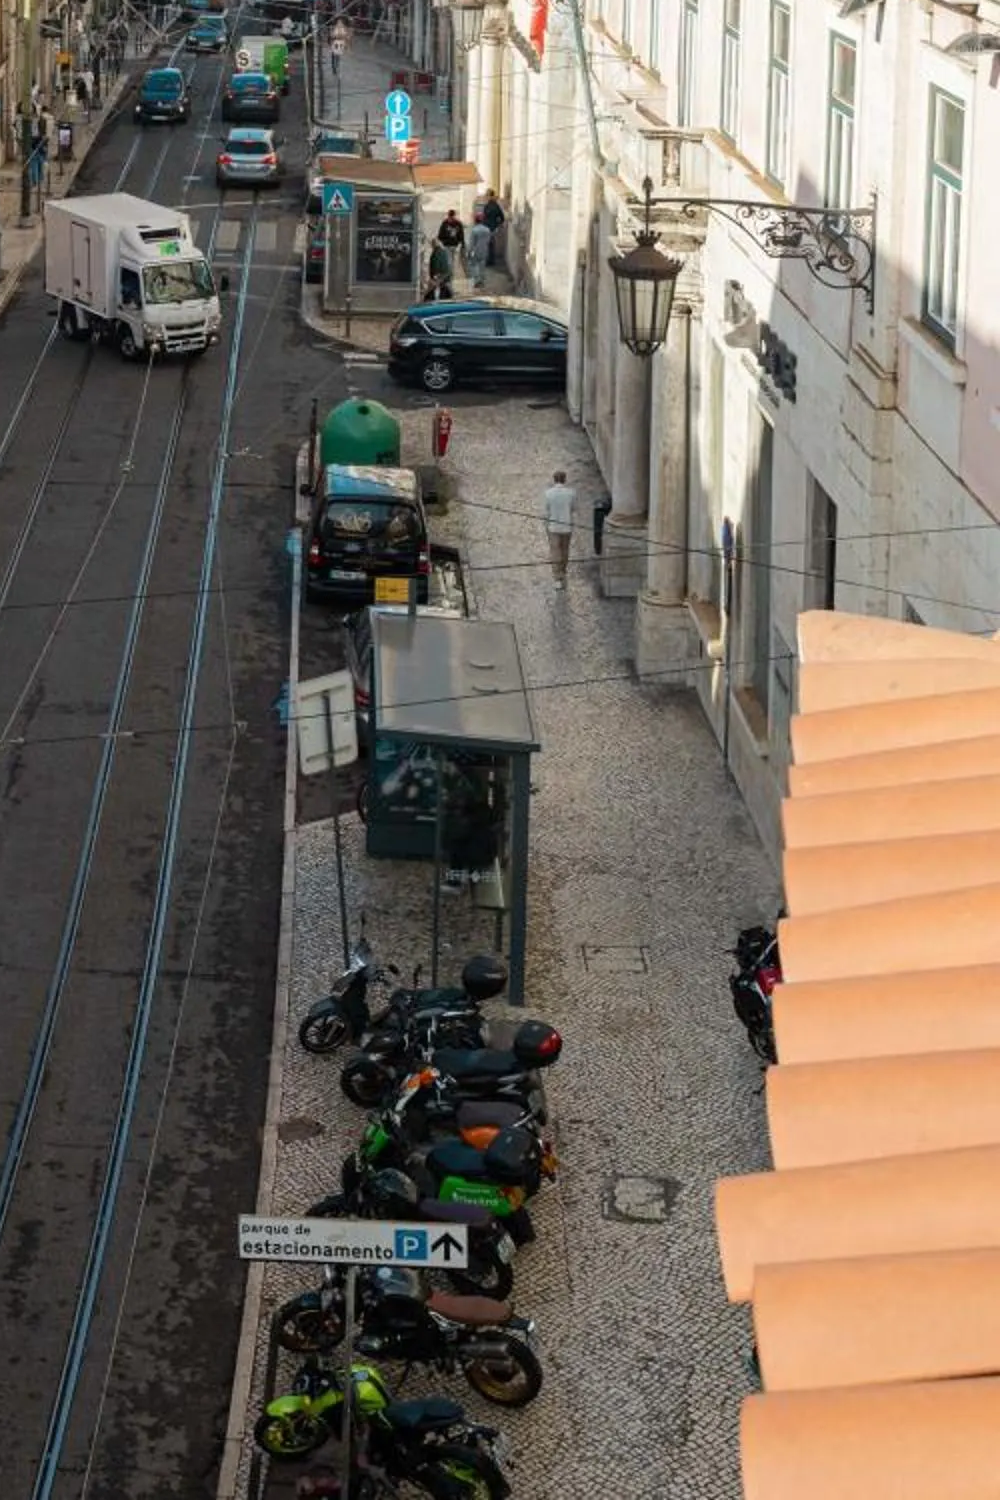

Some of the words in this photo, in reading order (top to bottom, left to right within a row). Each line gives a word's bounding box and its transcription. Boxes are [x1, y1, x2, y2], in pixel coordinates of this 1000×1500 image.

[391, 117, 405, 140] P
[241, 1223, 289, 1235] parque
[294, 1224, 311, 1236] de
[243, 1239, 393, 1259] estacionamento
[403, 1235, 419, 1257] P
